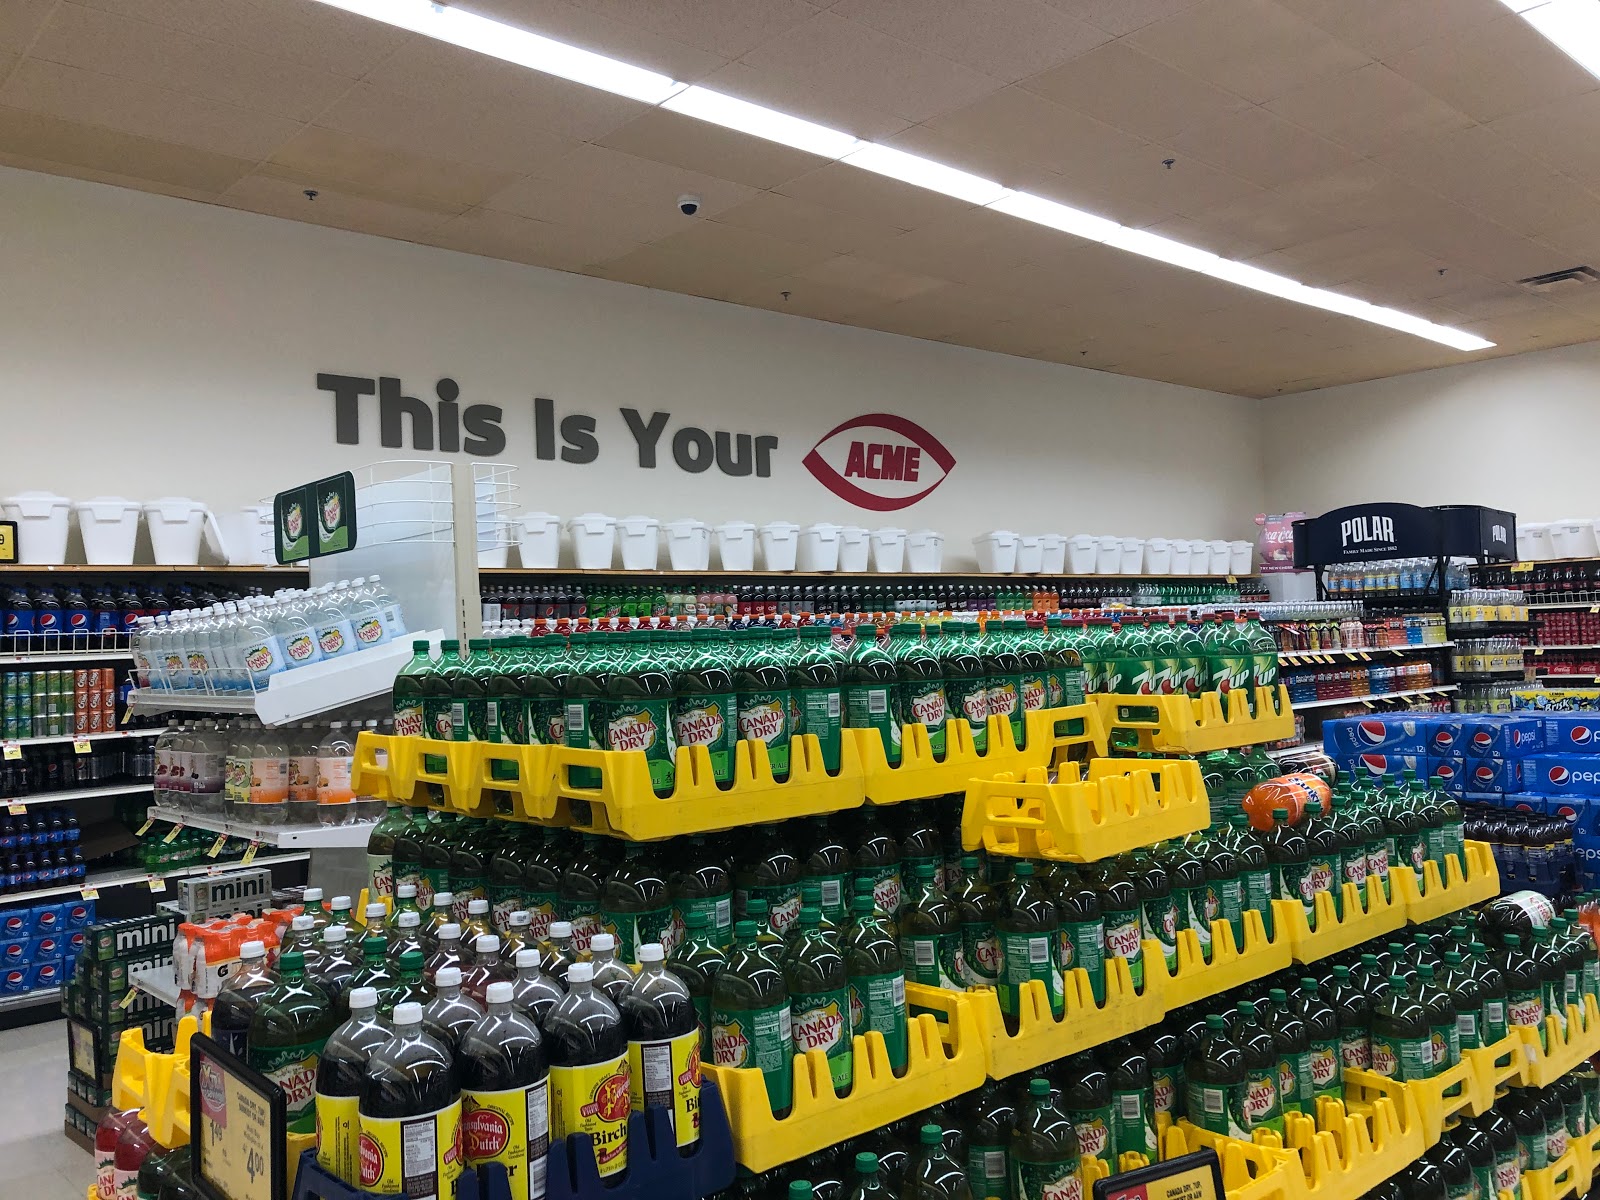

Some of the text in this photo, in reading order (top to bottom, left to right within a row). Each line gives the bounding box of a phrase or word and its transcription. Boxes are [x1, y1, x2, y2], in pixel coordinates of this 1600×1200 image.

[317, 373, 921, 482] This Is Your ACME
[1341, 516, 1395, 547] POLAR
[358, 623, 382, 640] CANADA
[366, 630, 381, 641] DRY
[288, 640, 313, 657] CANADA
[319, 634, 343, 650] CANADA
[326, 640, 341, 652] DRY
[248, 650, 272, 669] CANADA
[297, 647, 311, 658] DRY
[255, 658, 269, 669] DRY
[911, 697, 945, 717] CANAD
[986, 691, 1018, 707] ANADA
[927, 708, 943, 722] DRY
[990, 701, 1012, 715] DRY
[677, 715, 724, 738] CANADA
[738, 709, 786, 733] CANADA
[401, 723, 422, 736] DRY
[608, 720, 657, 745] CANADA
[687, 728, 714, 744] DRY
[753, 722, 778, 738] DRY
[1346, 726, 1361, 748] pepsi
[1521, 730, 1536, 745] pepsi
[619, 734, 646, 751] DRY
[1572, 771, 1600, 785] pep
[211, 874, 265, 902] mini
[374, 876, 393, 889] CAN
[117, 918, 175, 951] mini
[1121, 941, 1140, 955] DRY
[217, 965, 229, 978] G
[792, 1011, 844, 1041] CANADA
[1521, 1014, 1540, 1026] DRY
[806, 1028, 835, 1048] DRY
[716, 1047, 737, 1064] DRY
[279, 1069, 316, 1090] NAD
[838, 1072, 849, 1081] ALE
[1154, 1096, 1168, 1108] RY
[591, 1123, 627, 1146] Birch
[1166, 1187, 1184, 1198] CANADA
